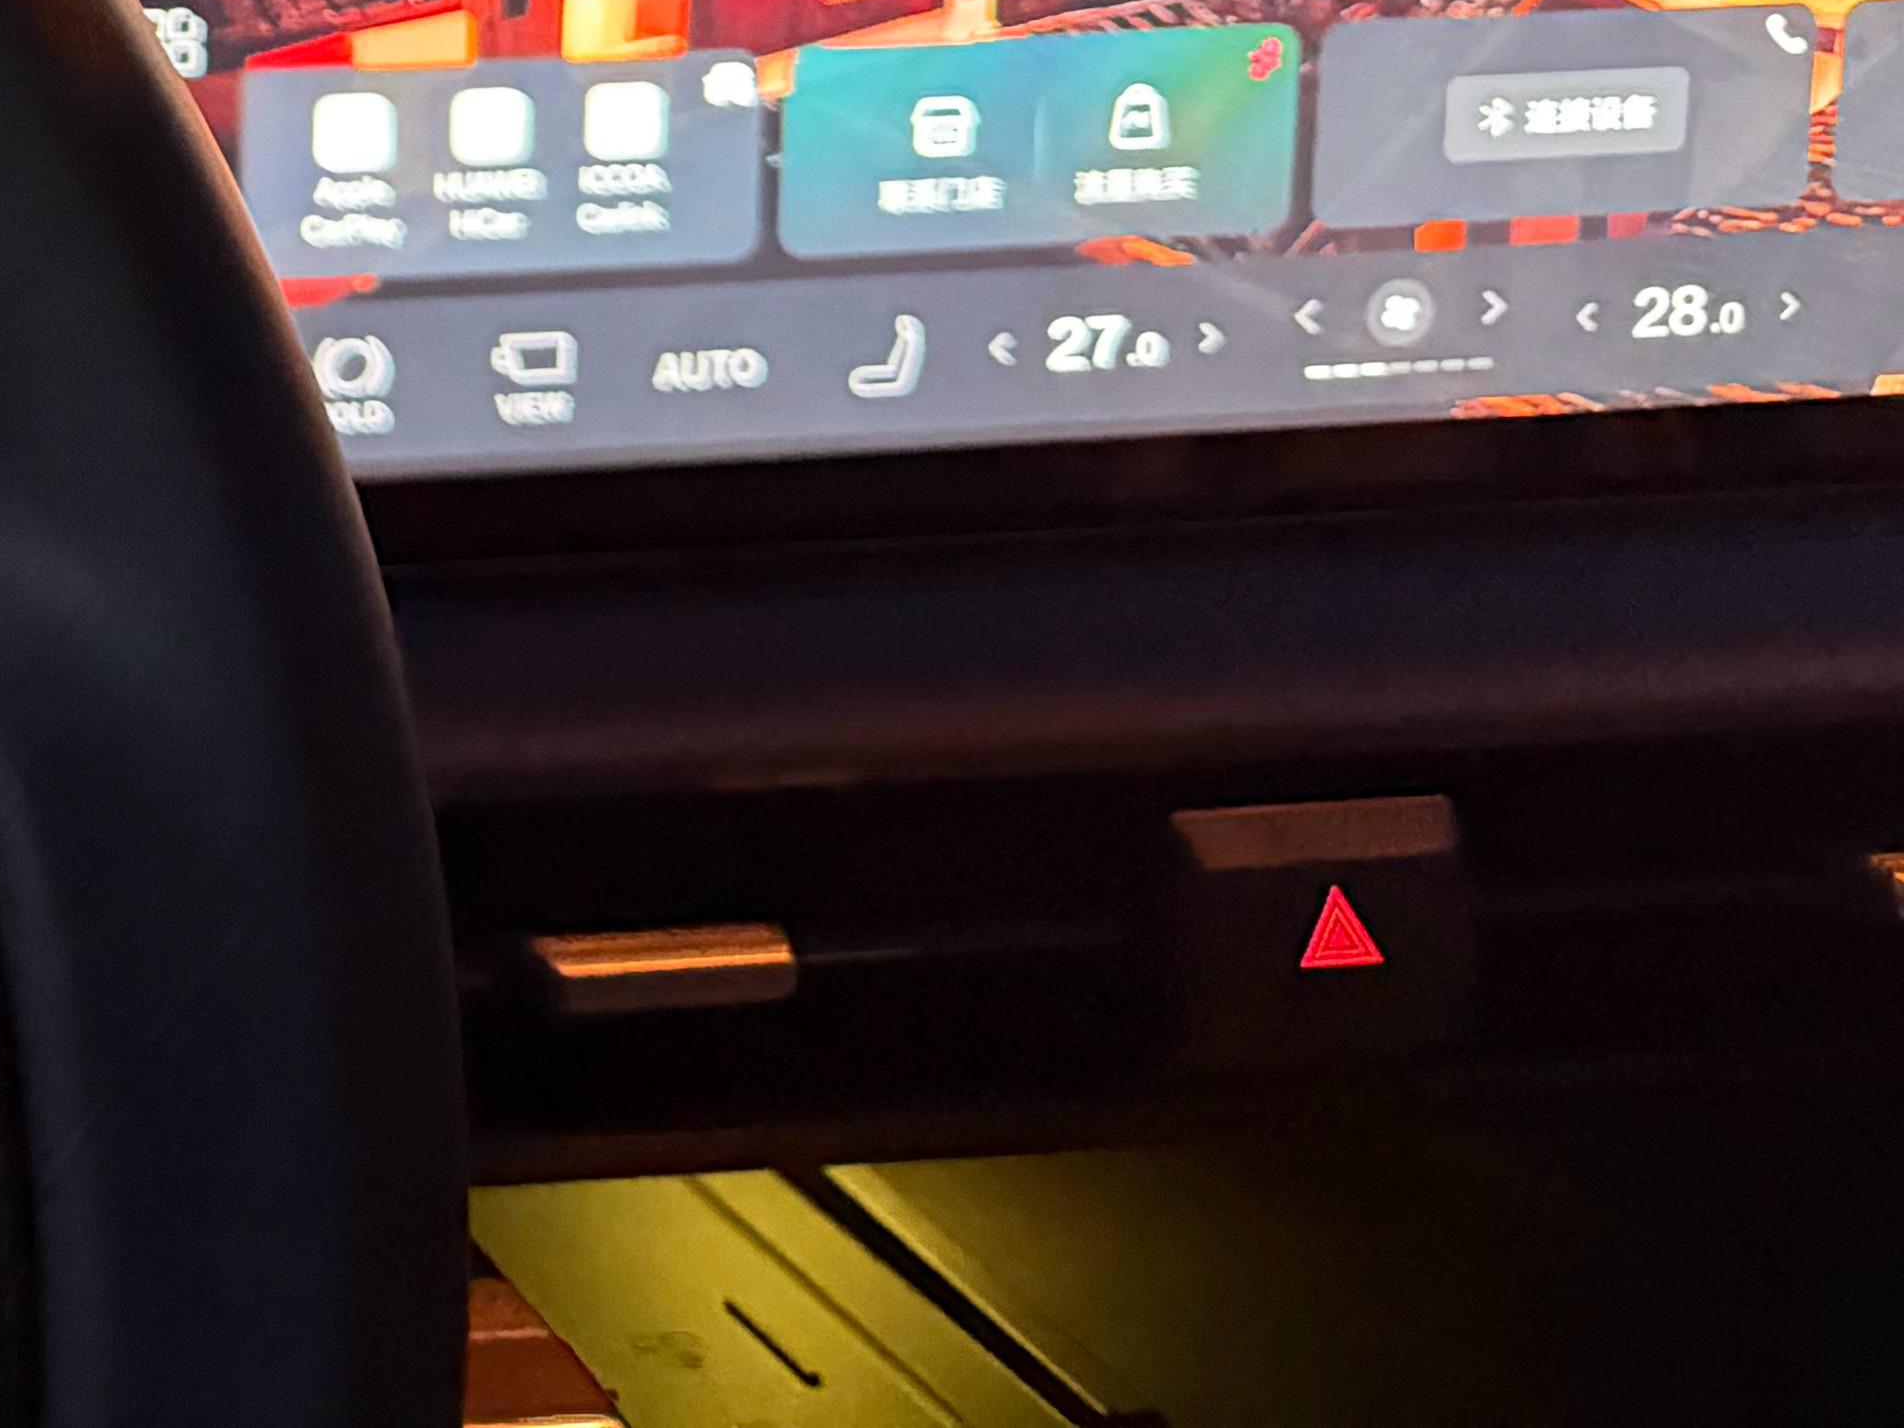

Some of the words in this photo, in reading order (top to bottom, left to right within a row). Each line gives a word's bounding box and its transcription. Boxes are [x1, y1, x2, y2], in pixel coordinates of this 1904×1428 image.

[1630, 284, 1746, 340] 28.0
[1044, 314, 1172, 374] 27.0
[651, 347, 769, 393] AUTO
[323, 399, 396, 435] OLD
[493, 391, 577, 426] VIEW
